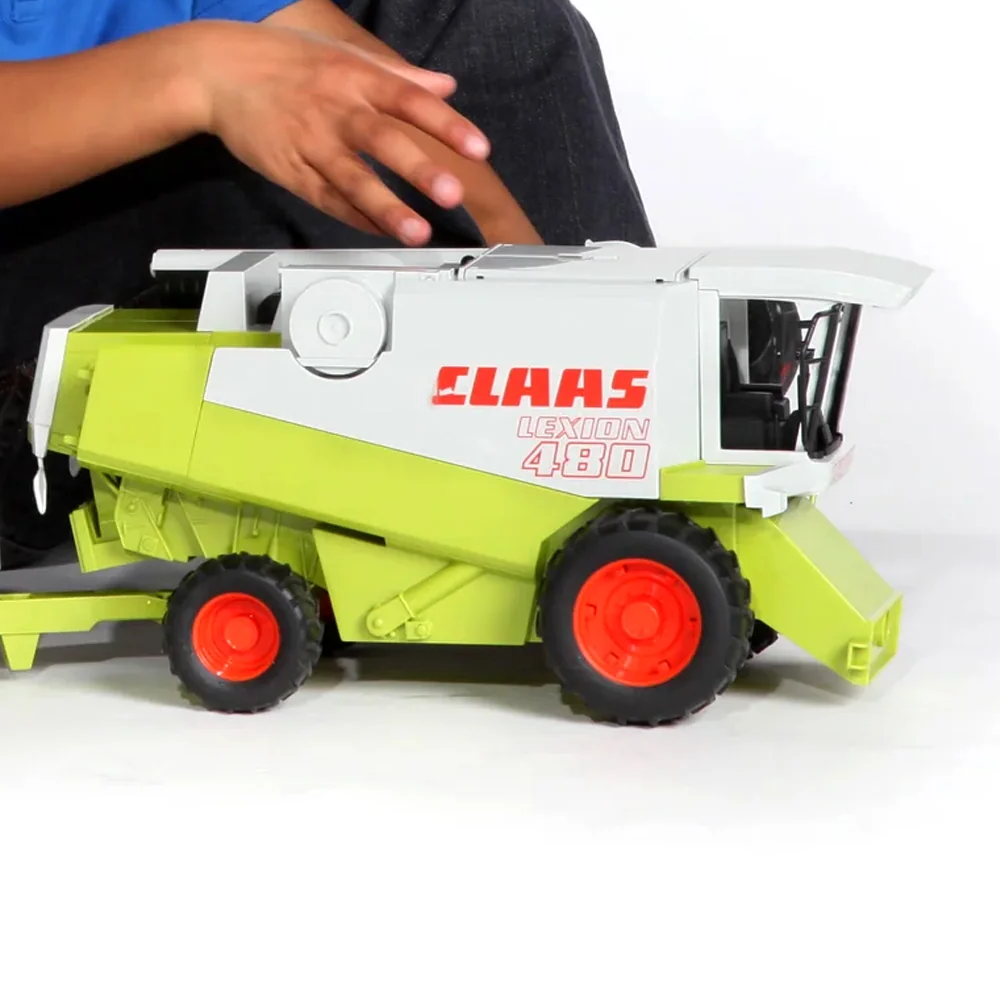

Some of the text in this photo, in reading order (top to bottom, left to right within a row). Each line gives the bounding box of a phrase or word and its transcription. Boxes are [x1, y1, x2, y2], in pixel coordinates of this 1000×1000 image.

[431, 366, 649, 409] CLAAS
[517, 416, 650, 440] LEXION
[521, 441, 651, 479] 480
